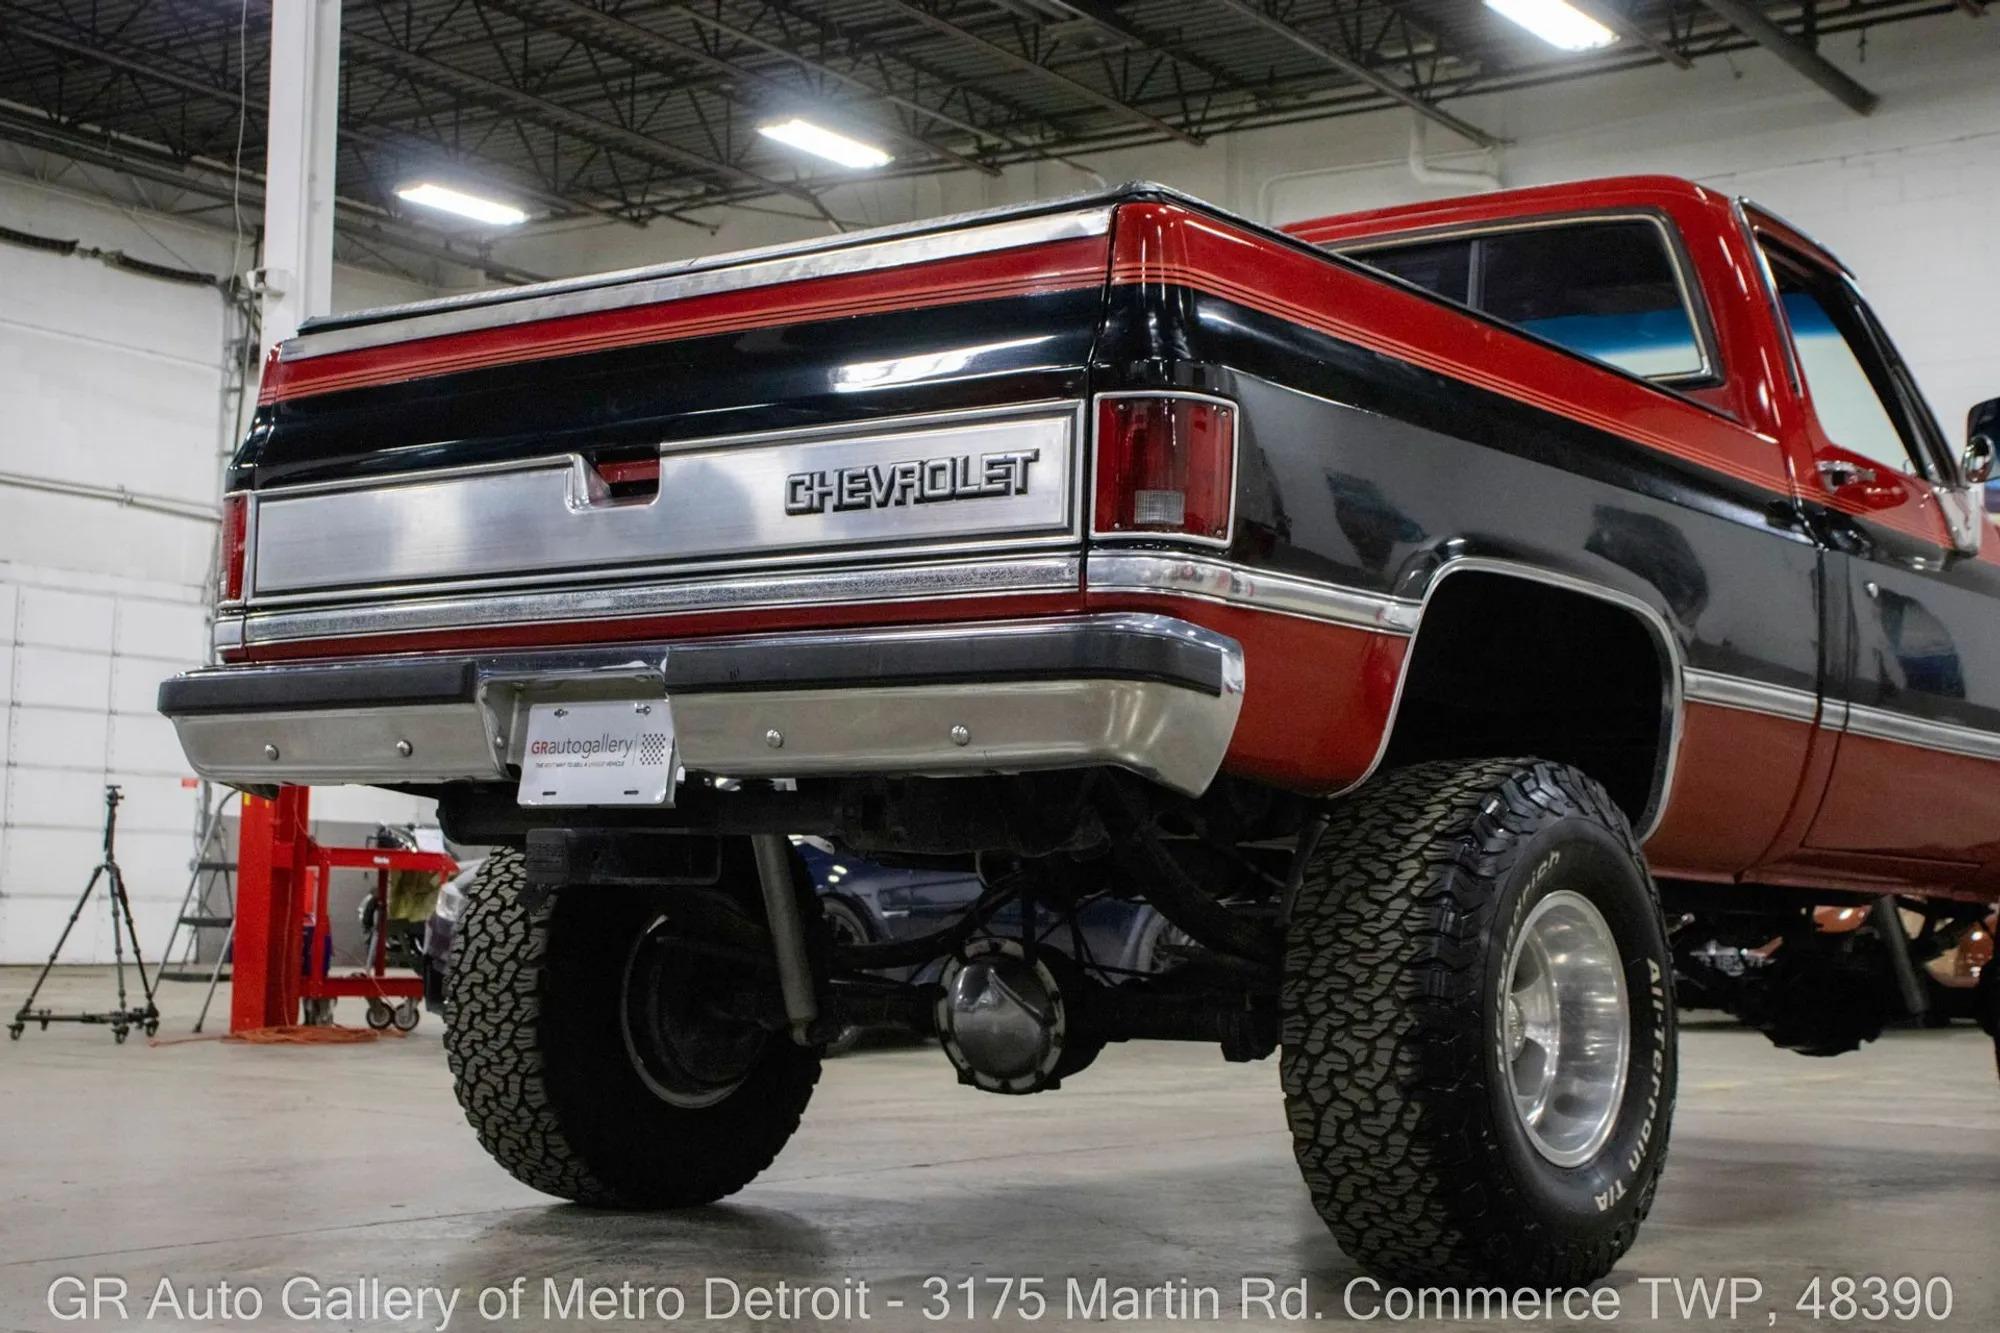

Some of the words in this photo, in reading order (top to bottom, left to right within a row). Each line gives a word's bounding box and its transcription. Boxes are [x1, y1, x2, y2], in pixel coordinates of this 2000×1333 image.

[784, 448, 1040, 516] CHEVROLET
[531, 733, 633, 759] GRautogallery
[1628, 957, 1665, 1172] All-Terrain
